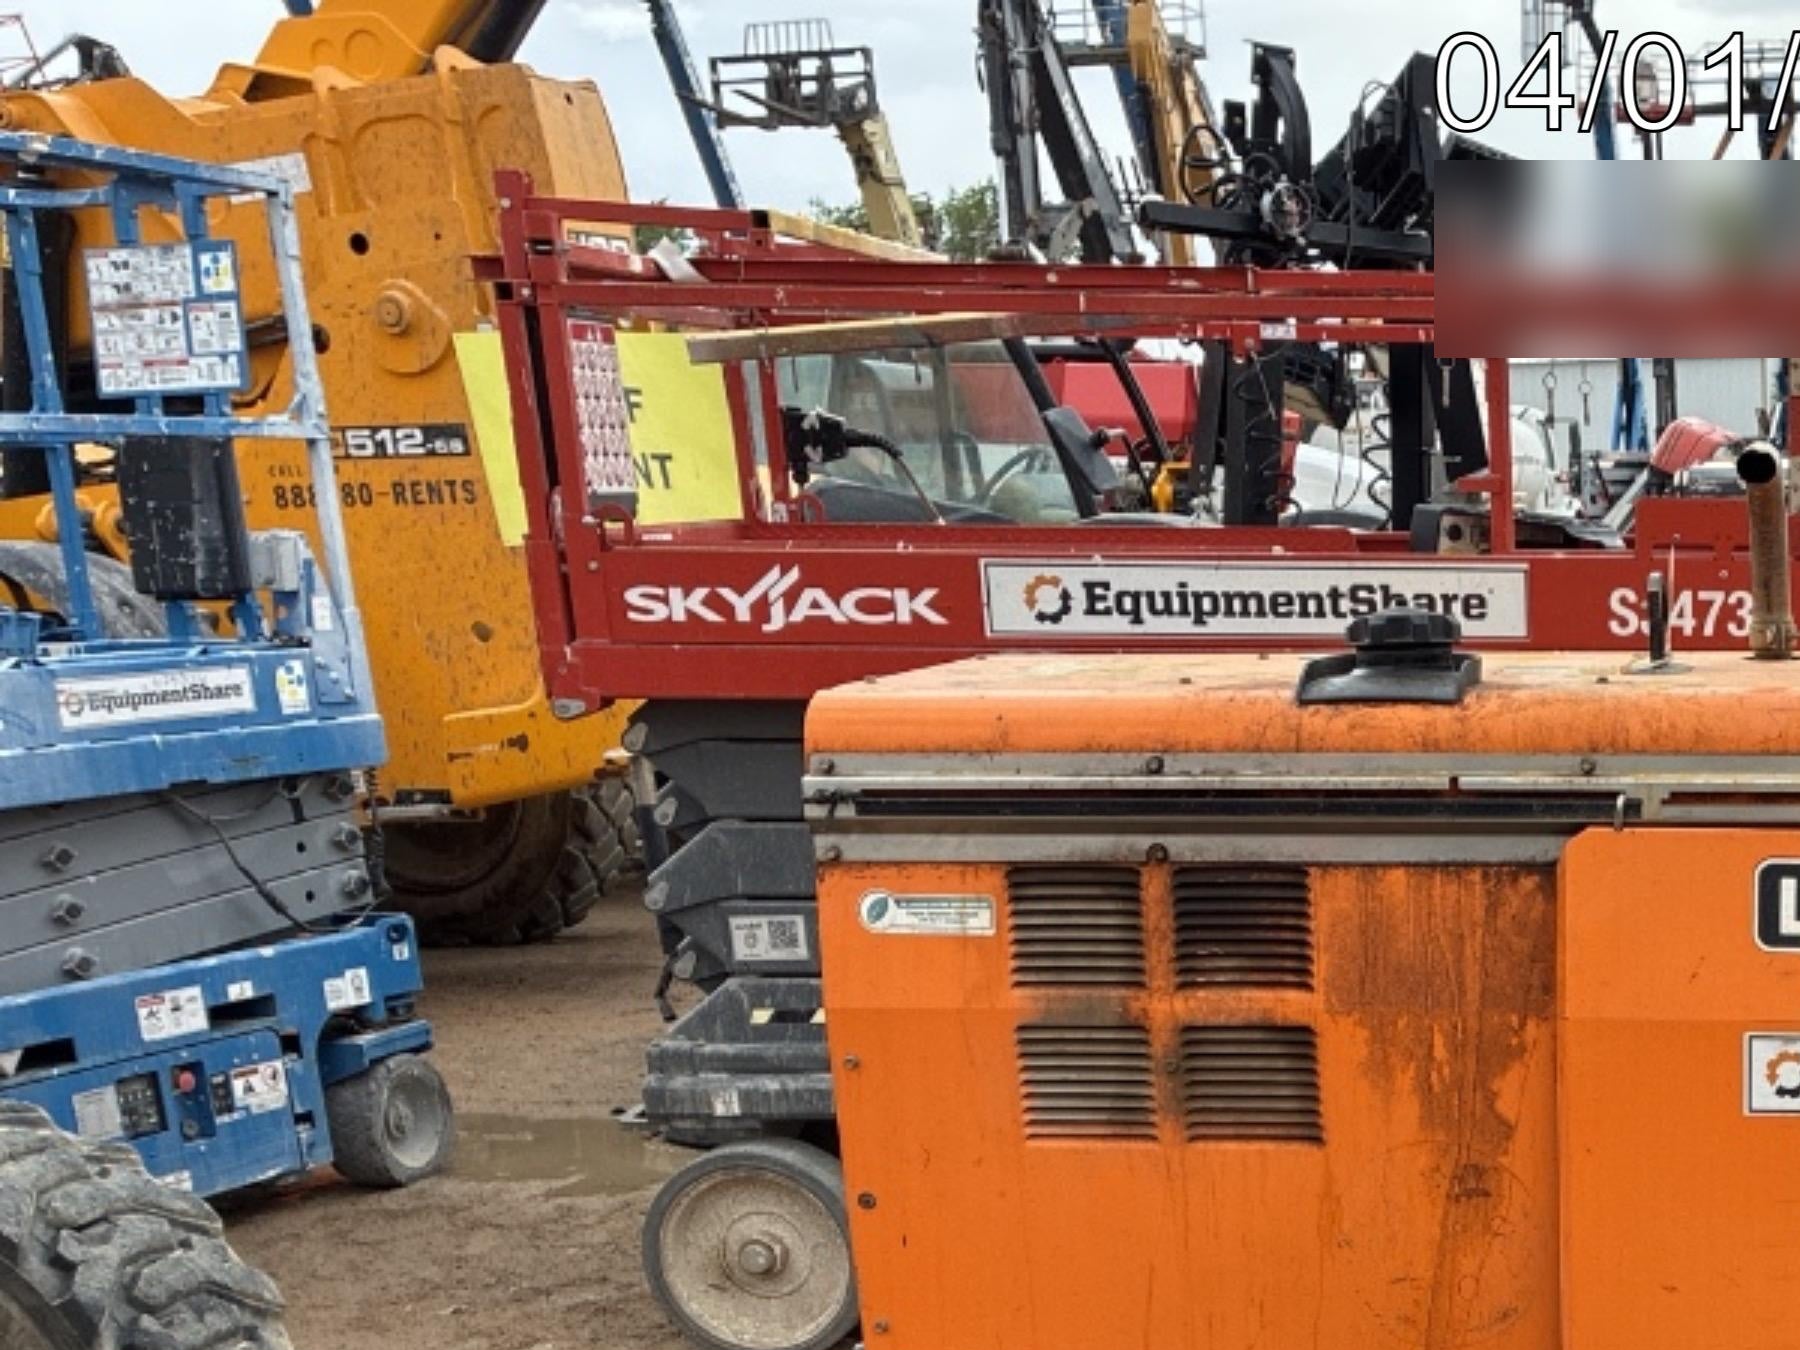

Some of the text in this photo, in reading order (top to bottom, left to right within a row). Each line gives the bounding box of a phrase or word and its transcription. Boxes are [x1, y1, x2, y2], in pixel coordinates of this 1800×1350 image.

[623, 563, 949, 633] SKYJACK
[1082, 582, 1489, 625] EquipmentShare
[1608, 587, 1753, 637] S473
[86, 683, 244, 713] EquipmentShare
